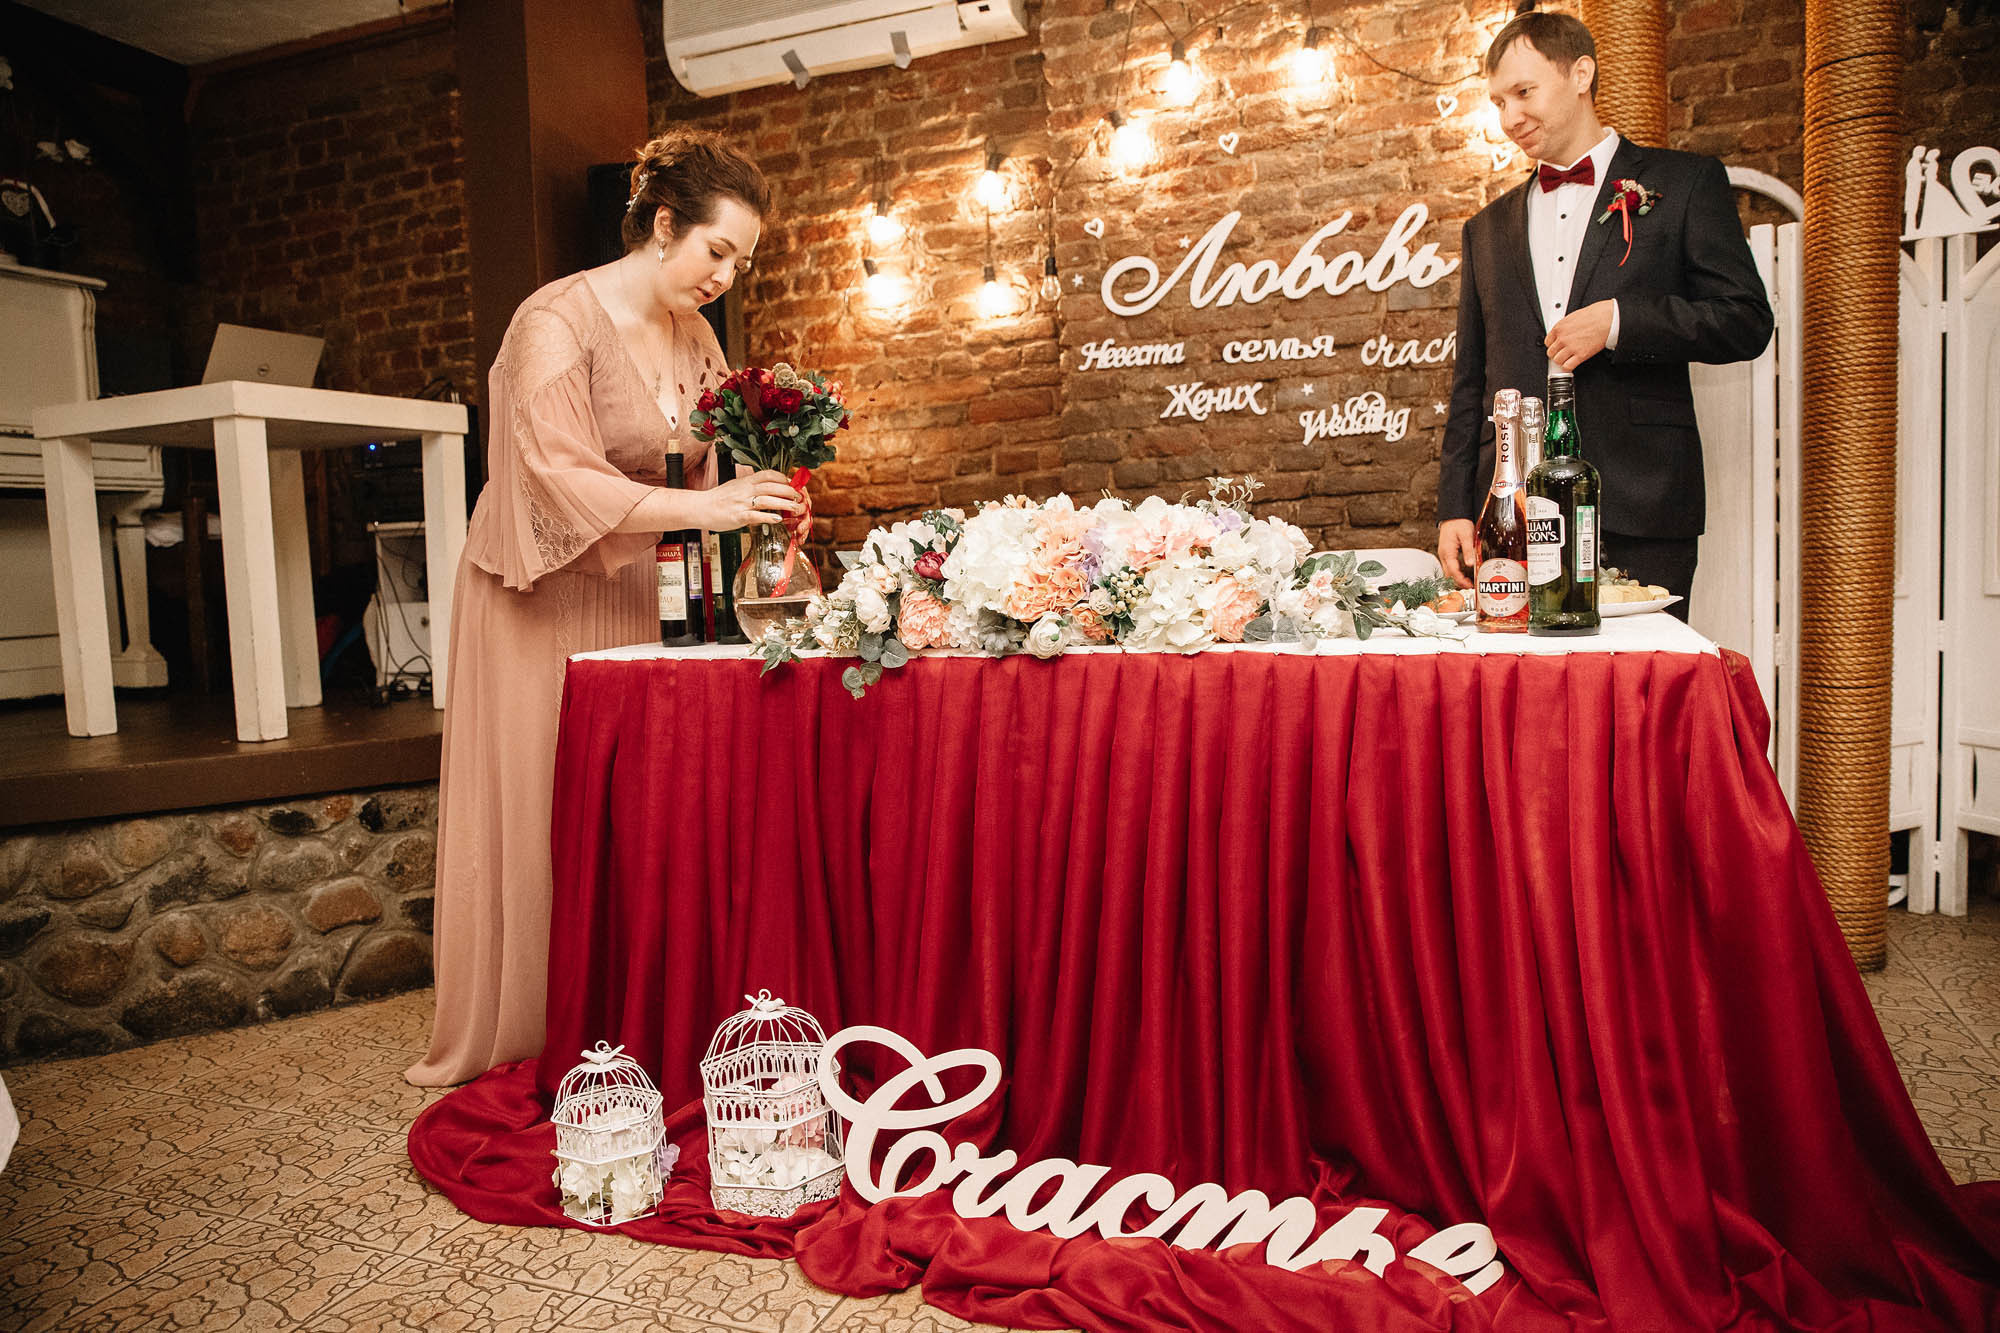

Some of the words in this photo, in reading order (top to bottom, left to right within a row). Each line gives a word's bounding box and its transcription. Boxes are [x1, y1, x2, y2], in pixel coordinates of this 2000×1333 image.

[1101, 202, 1460, 316] Любовь
[1078, 338, 1185, 371] Невеста
[1222, 334, 1336, 364] семья
[1159, 381, 1268, 421] Жених
[1299, 391, 1411, 446] Wedding
[1479, 581, 1525, 593] MARTINI
[817, 1024, 1506, 1297] Счастье
